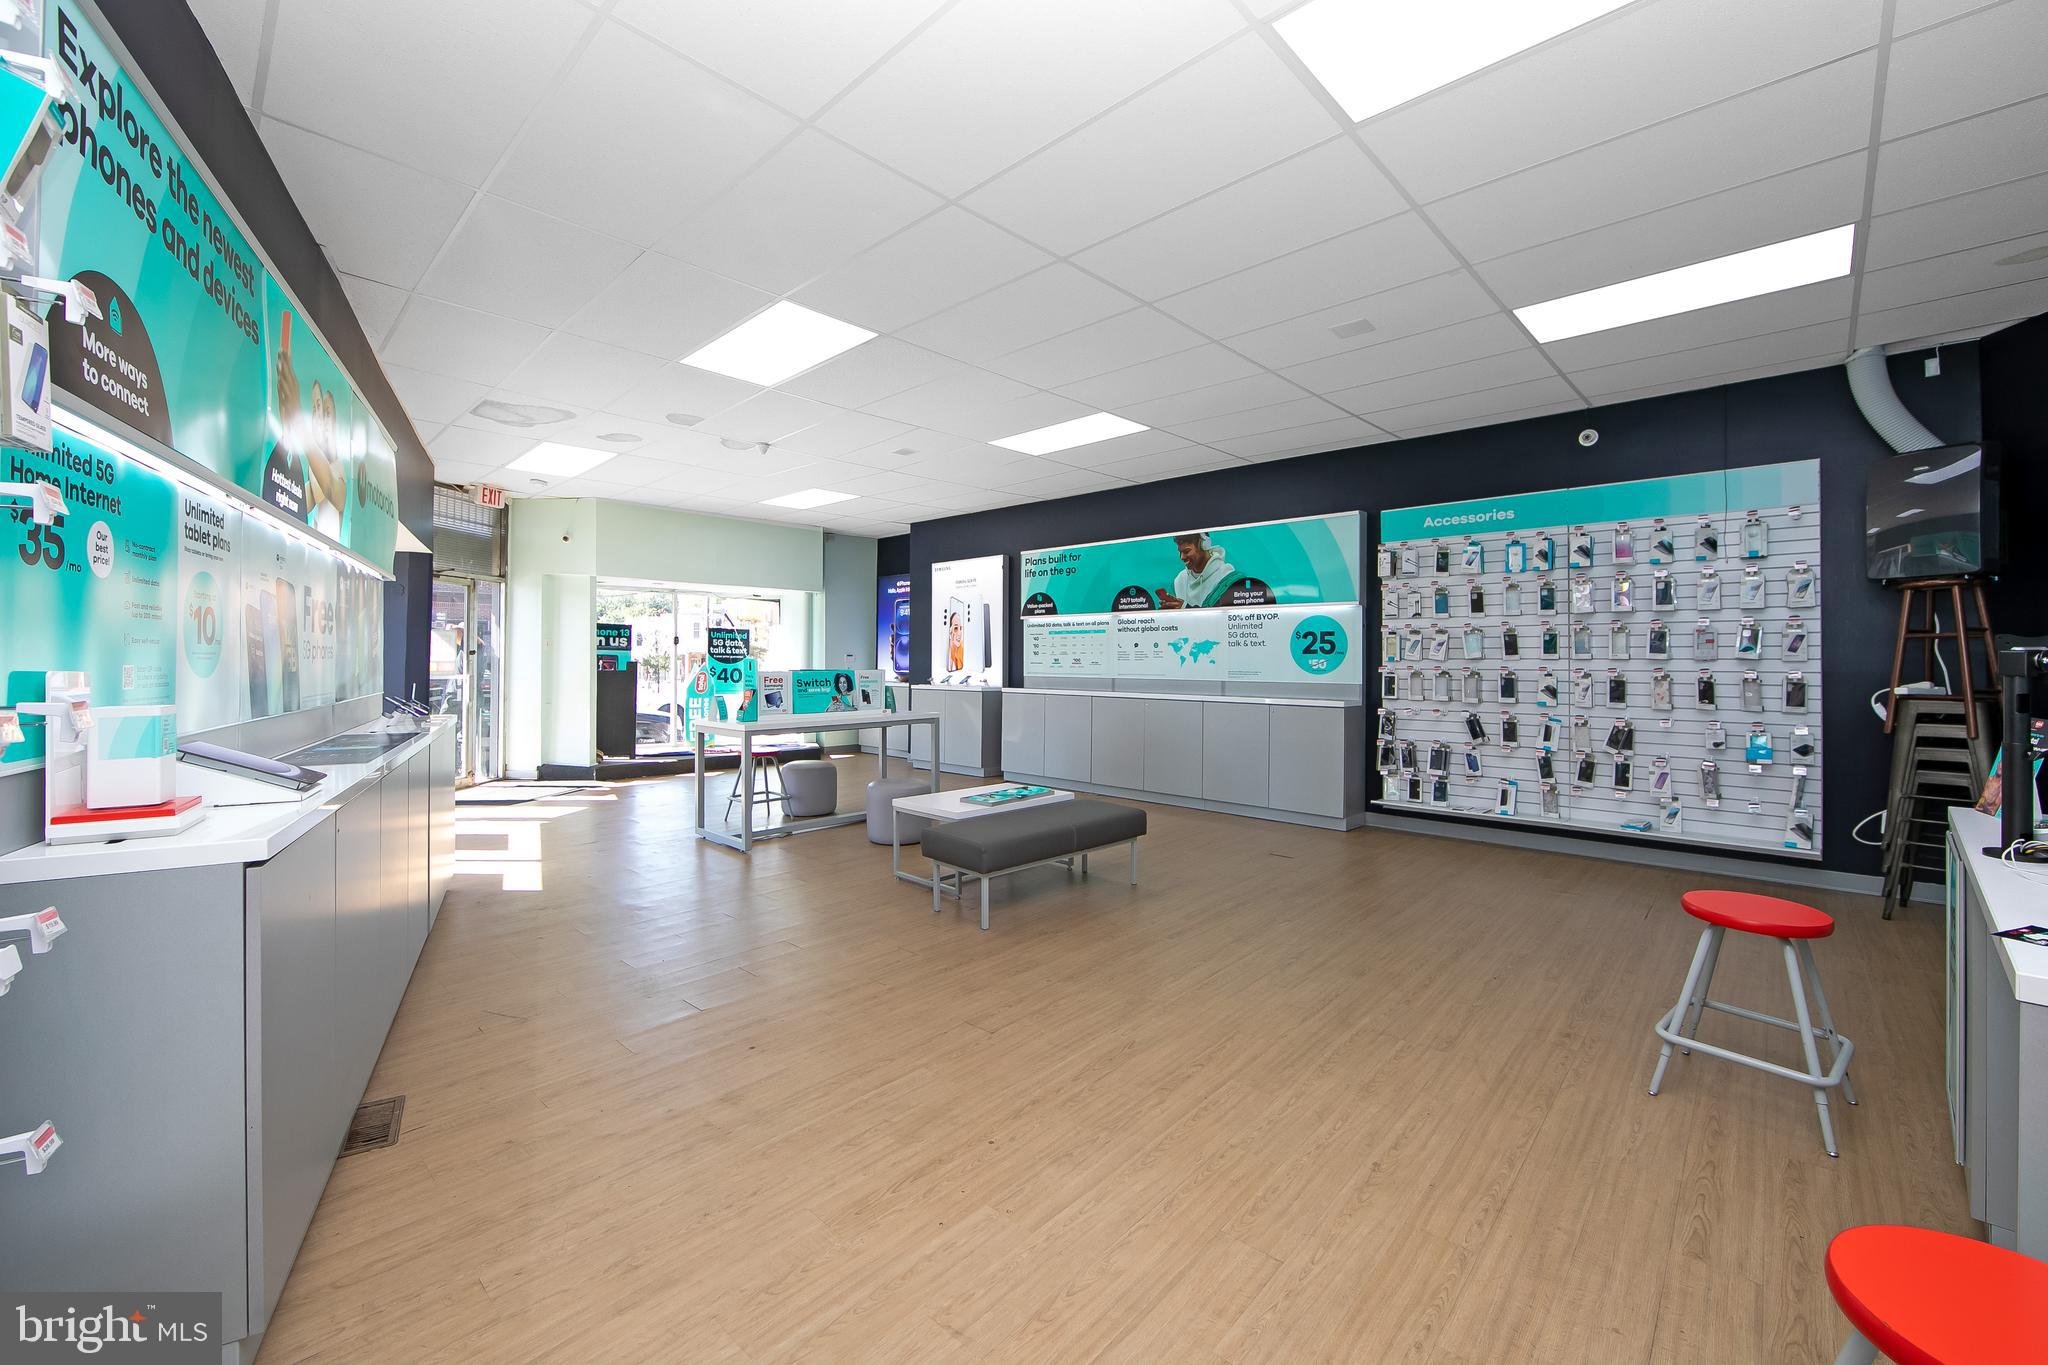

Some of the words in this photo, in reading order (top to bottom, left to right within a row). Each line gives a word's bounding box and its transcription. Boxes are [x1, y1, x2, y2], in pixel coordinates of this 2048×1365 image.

[58, 6, 163, 179] Explore
[167, 157, 199, 226] the
[203, 211, 256, 299] newest
[59, 101, 158, 234] phones
[162, 216, 200, 282] and
[203, 262, 260, 346] devices
[82, 325, 117, 368] More
[118, 357, 149, 390] ways
[82, 358, 99, 386] to
[101, 373, 150, 417] connect
[96, 459, 115, 486] 5G
[65, 476, 122, 517] Internet
[481, 487, 503, 507] EXIT
[185, 498, 225, 530] Unlimited
[1423, 509, 1515, 528] Accessories
[96, 530, 108, 542] Our
[184, 522, 211, 546] tablet
[212, 532, 231, 553] plans
[95, 543, 109, 554] best
[93, 555, 110, 567] price!
[1025, 557, 1047, 567] Plans
[1048, 554, 1068, 564] built
[1069, 553, 1082, 562] for
[1025, 569, 1036, 578] life
[1038, 569, 1048, 577] on
[1050, 567, 1064, 576] the
[1065, 566, 1077, 576] go
[1233, 591, 1249, 599] Bring
[304, 585, 334, 635] Free
[189, 602, 216, 646] $10
[1117, 625, 1140, 633] without
[1141, 625, 1160, 633] global
[1228, 622, 1263, 630] Unlimited
[710, 631, 748, 640] Unlimited
[1239, 631, 1258, 639] data,
[609, 638, 628, 647] us
[725, 639, 745, 648] data,
[1296, 631, 1336, 655] $25
[303, 640, 311, 660] 5G
[311, 640, 334, 664] phones
[710, 646, 725, 654] talk
[732, 647, 748, 655] text
[1308, 658, 1328, 669] $50
[709, 666, 742, 683] $40
[764, 676, 783, 684] Free
[796, 678, 832, 688] Switch
